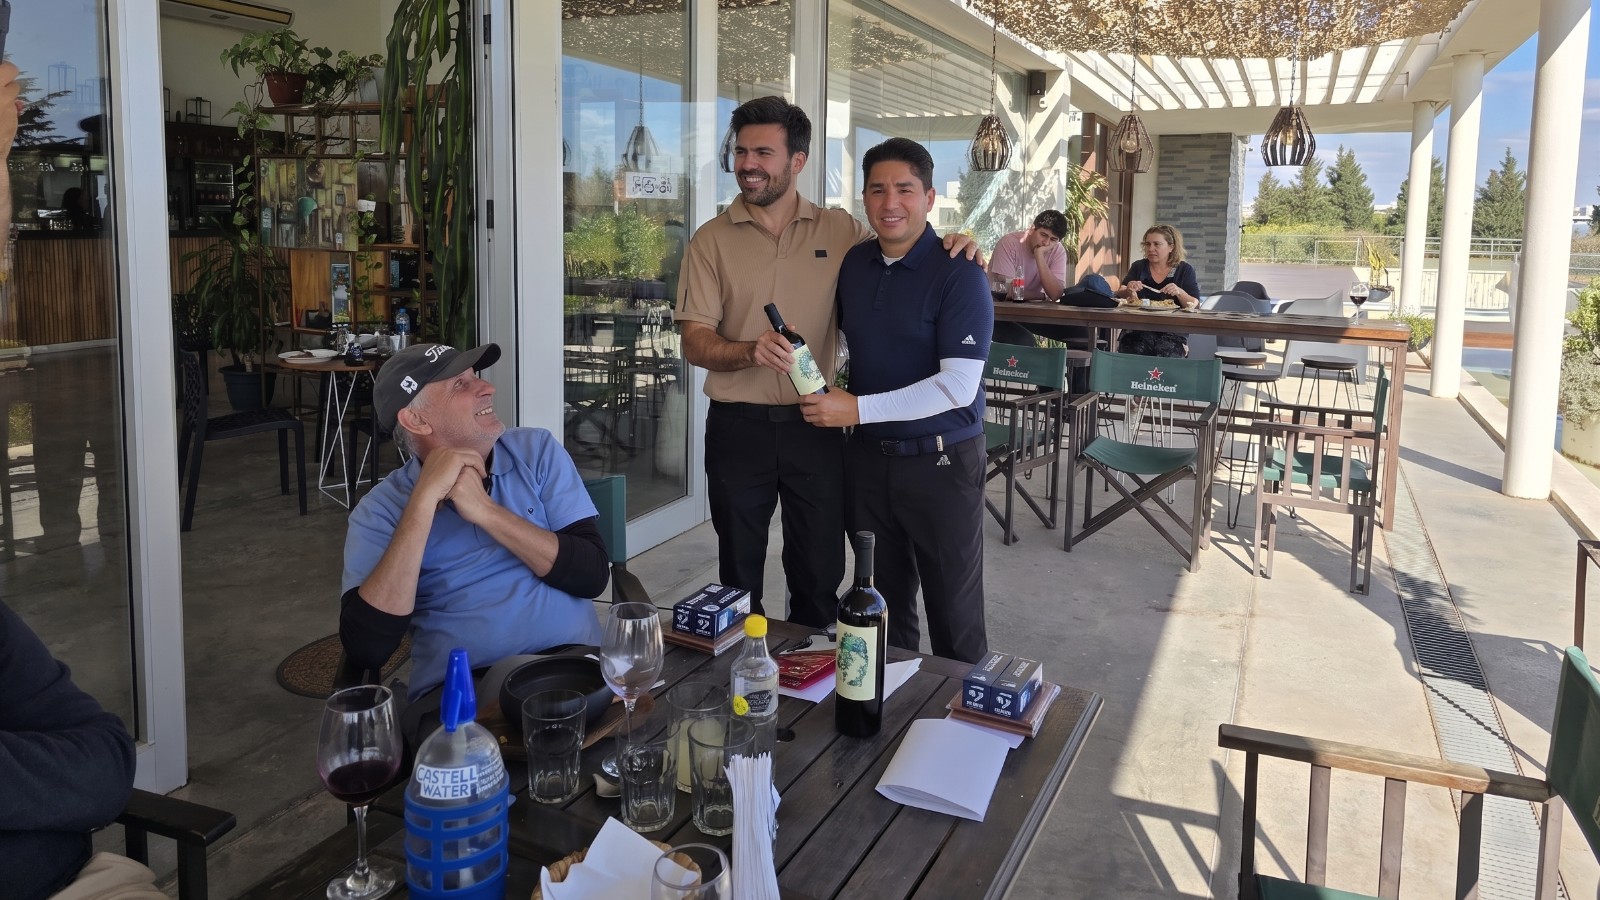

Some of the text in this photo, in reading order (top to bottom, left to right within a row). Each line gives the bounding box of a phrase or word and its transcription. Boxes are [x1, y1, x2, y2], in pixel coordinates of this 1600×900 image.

[993, 367, 1029, 379] Heineken
[1130, 381, 1177, 393] Heineken
[417, 767, 477, 785] CASTELL
[424, 784, 470, 798] WATER
